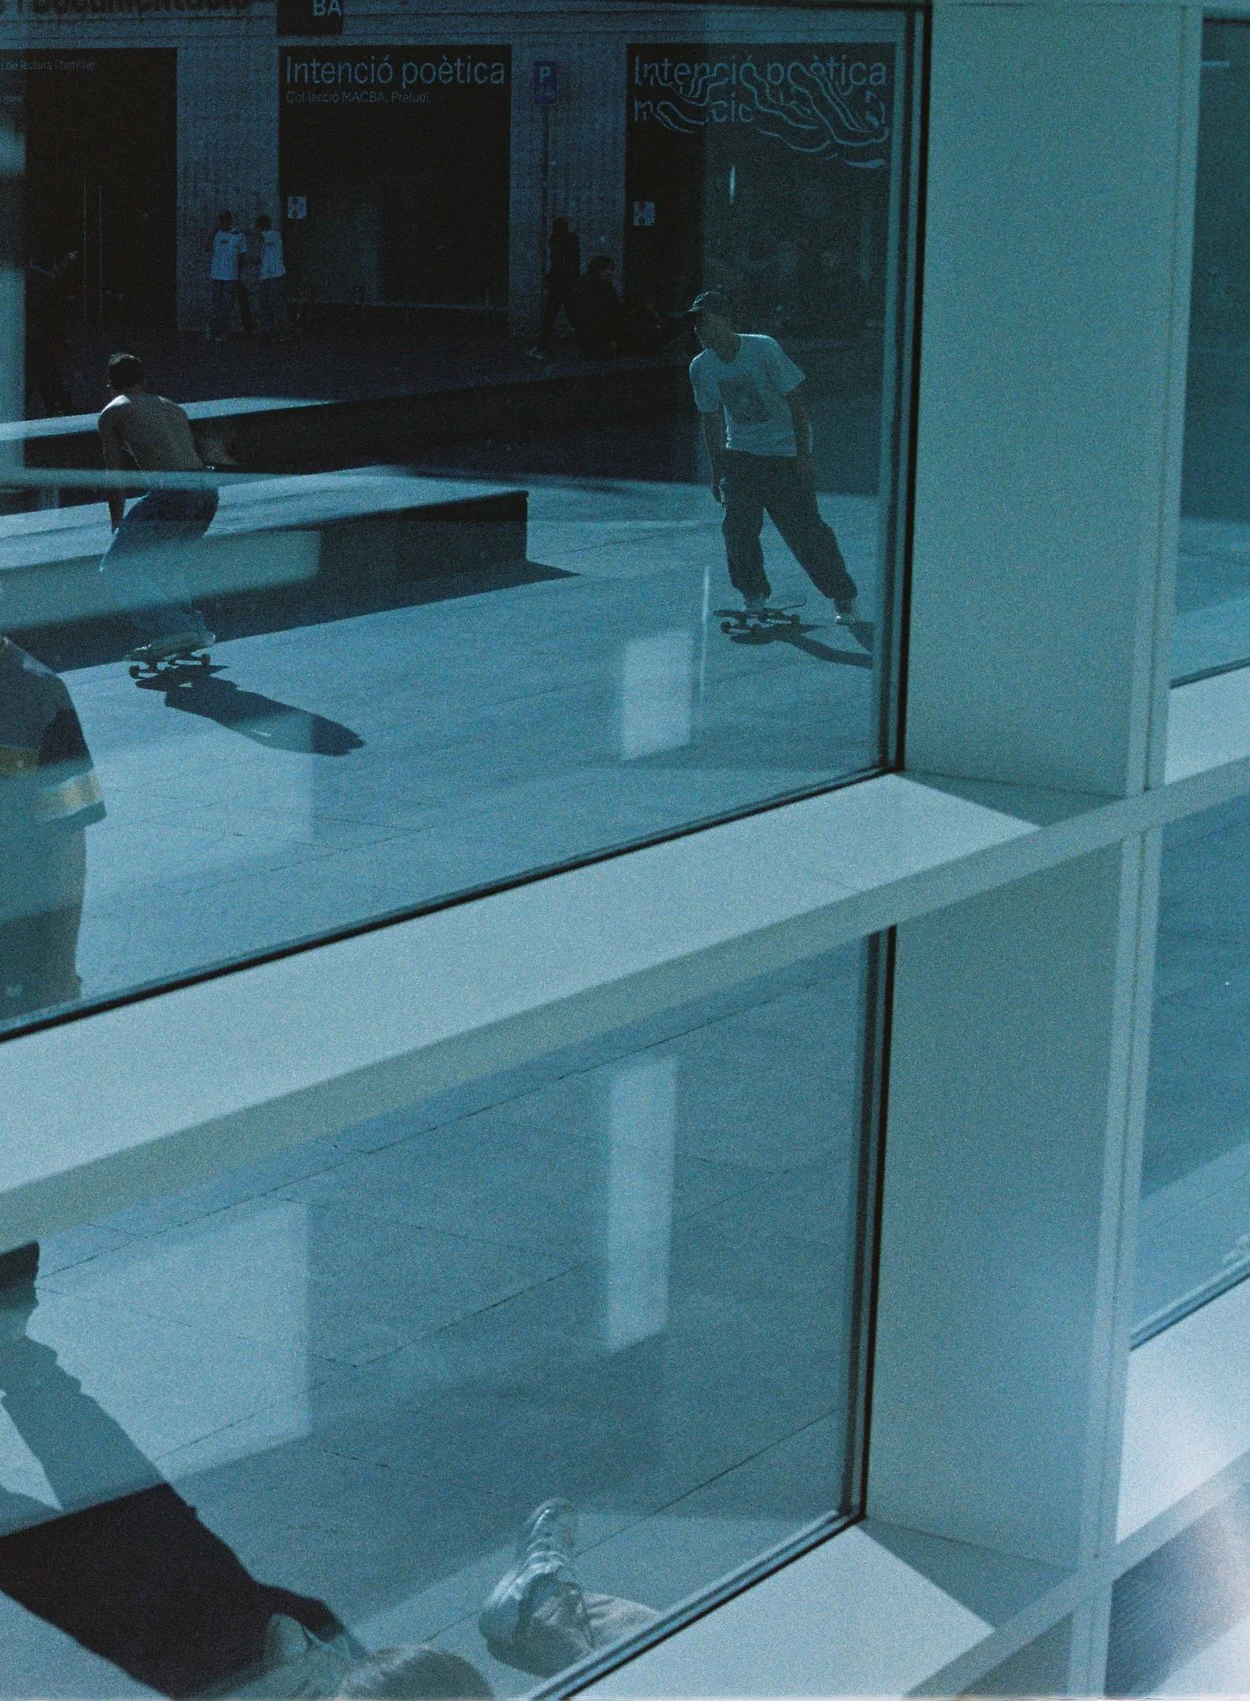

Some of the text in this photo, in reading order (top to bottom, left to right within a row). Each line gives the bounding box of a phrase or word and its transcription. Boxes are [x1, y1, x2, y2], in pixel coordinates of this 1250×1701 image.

[312, 0, 343, 17] BA
[285, 54, 505, 88] Intenció poètica
[539, 66, 552, 83] P
